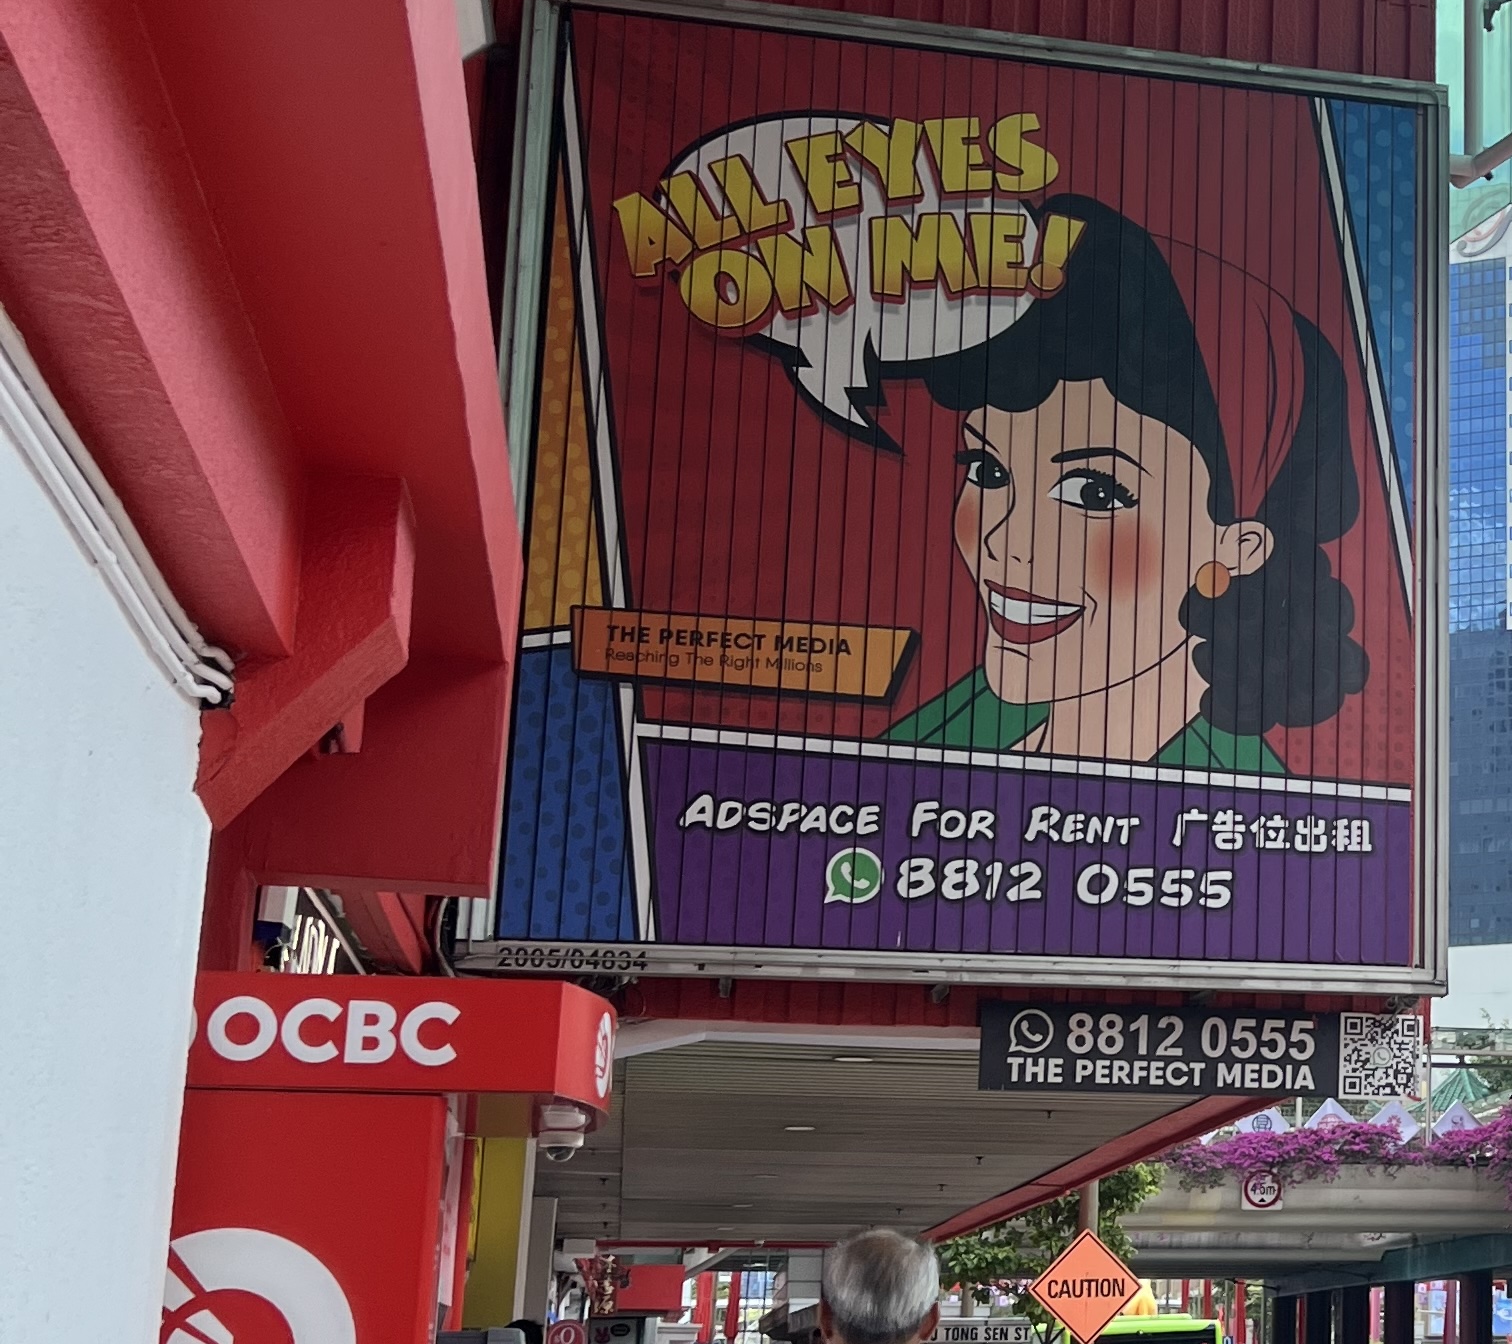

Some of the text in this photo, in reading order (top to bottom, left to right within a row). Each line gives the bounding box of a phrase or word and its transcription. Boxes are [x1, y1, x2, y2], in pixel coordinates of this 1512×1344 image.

[613, 112, 1060, 277] ALL EYES
[679, 212, 1087, 328] ON ME!
[605, 647, 823, 673] Reaching The Right Mllions
[607, 625, 852, 656] THE PERFECT MEDIA
[1172, 807, 1373, 853] 广告位出租
[896, 856, 1234, 909] 8812 0555
[206, 995, 462, 1067] OCBC
[1066, 1011, 1316, 1061] 8812 0555
[1006, 1057, 1316, 1091] THE PERFECT MEDIA
[1047, 1278, 1126, 1300] CAUTION
[944, 1326, 979, 1341] TONG
[983, 1326, 1009, 1341] SEN
[1014, 1327, 1030, 1341] ST
